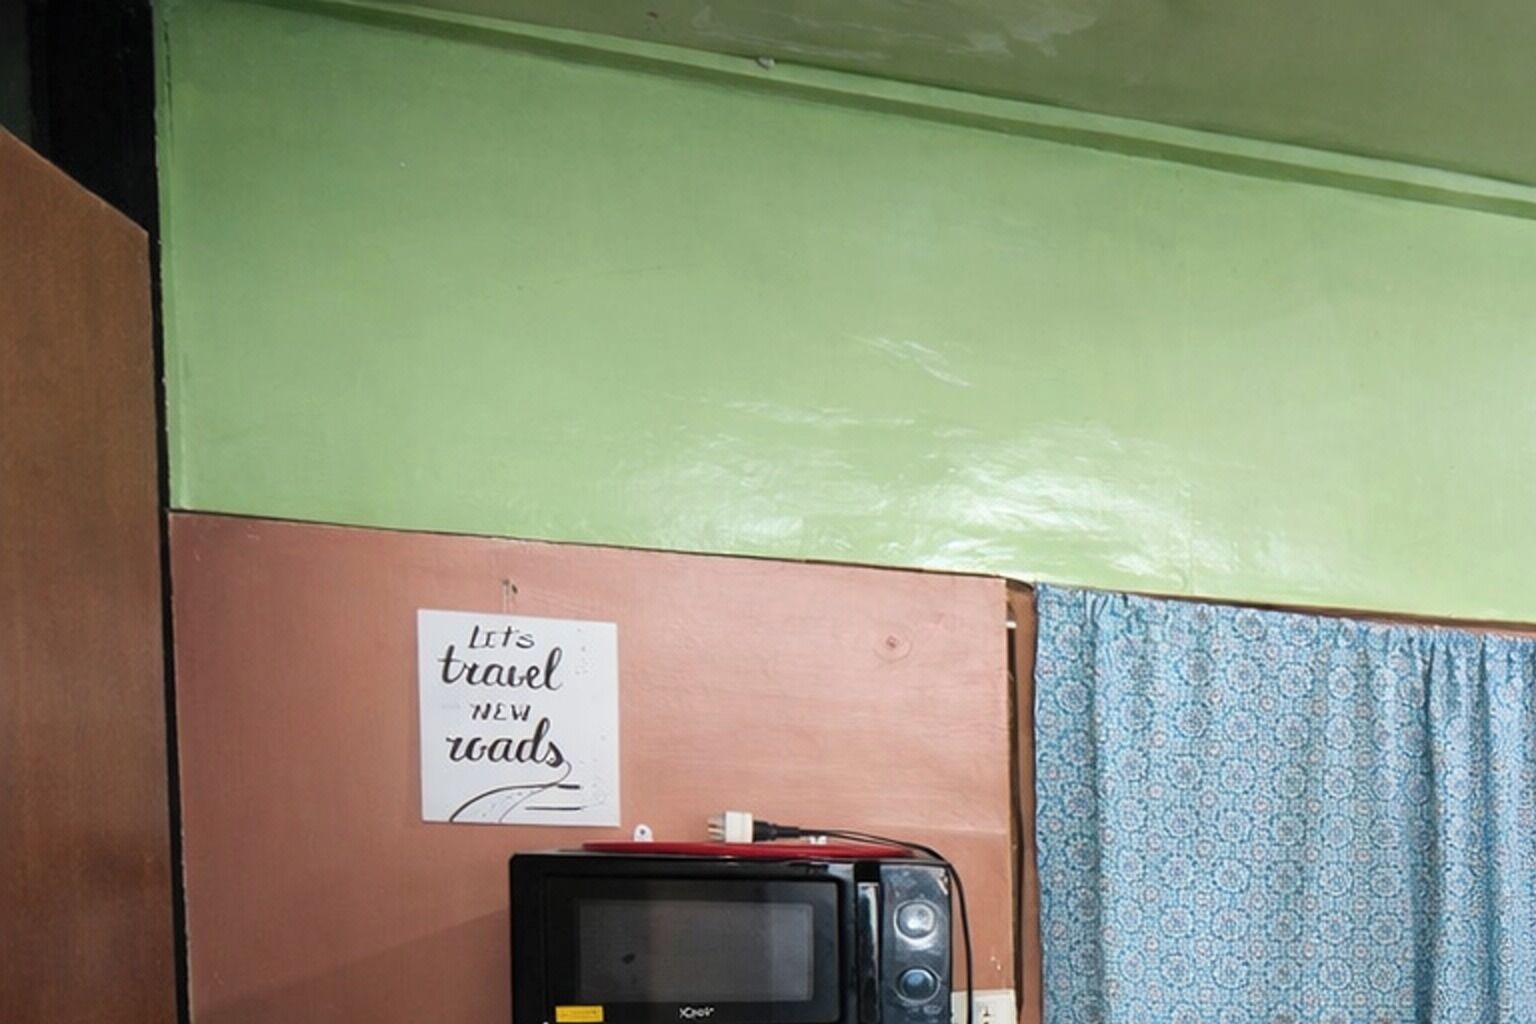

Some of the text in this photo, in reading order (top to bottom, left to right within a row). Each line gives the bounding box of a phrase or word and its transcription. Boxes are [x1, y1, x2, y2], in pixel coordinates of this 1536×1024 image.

[437, 645, 563, 691] travel
[470, 702, 531, 721] NEW
[445, 717, 565, 768] roads
